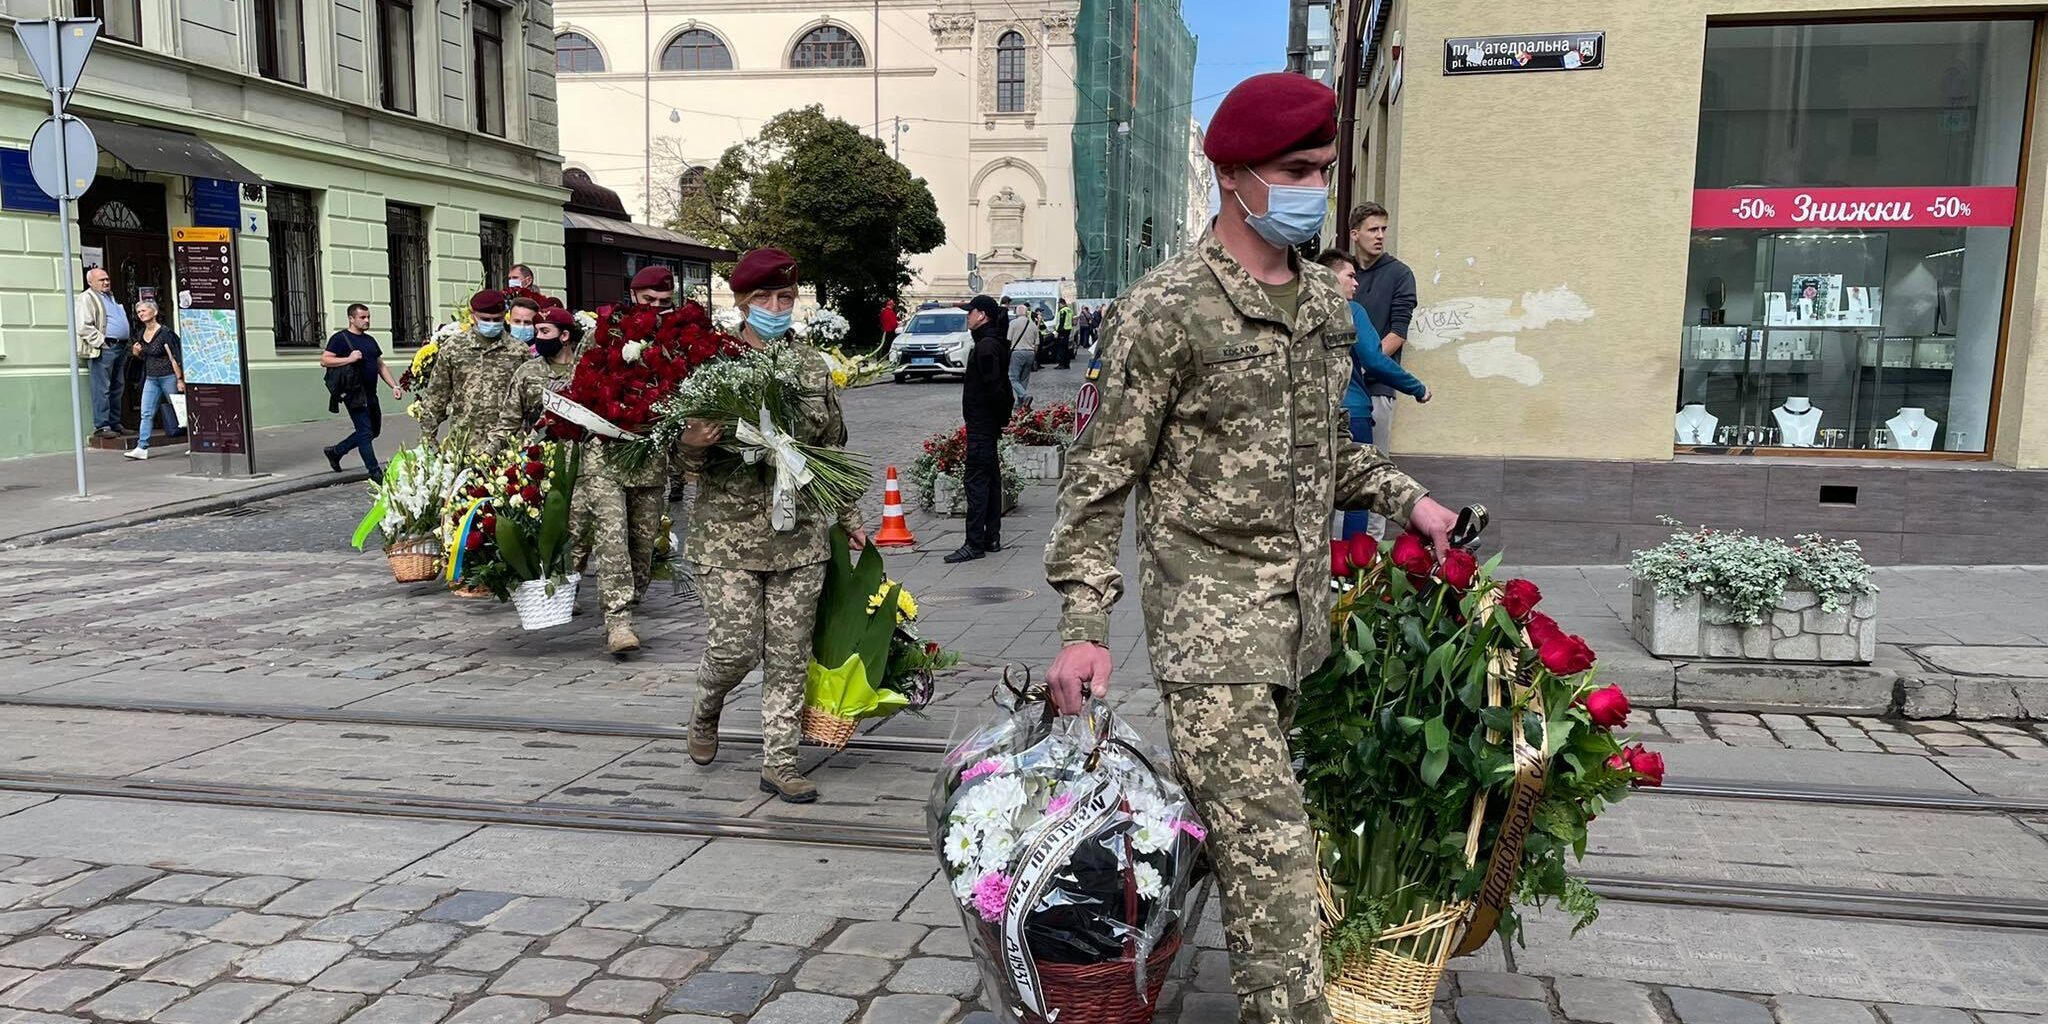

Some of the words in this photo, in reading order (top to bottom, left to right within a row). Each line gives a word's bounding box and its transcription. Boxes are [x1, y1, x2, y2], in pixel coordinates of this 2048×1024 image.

[1732, 198, 1776, 219] -50%
[1791, 194, 1914, 222] Знижки
[1926, 196, 1971, 218] -50%
